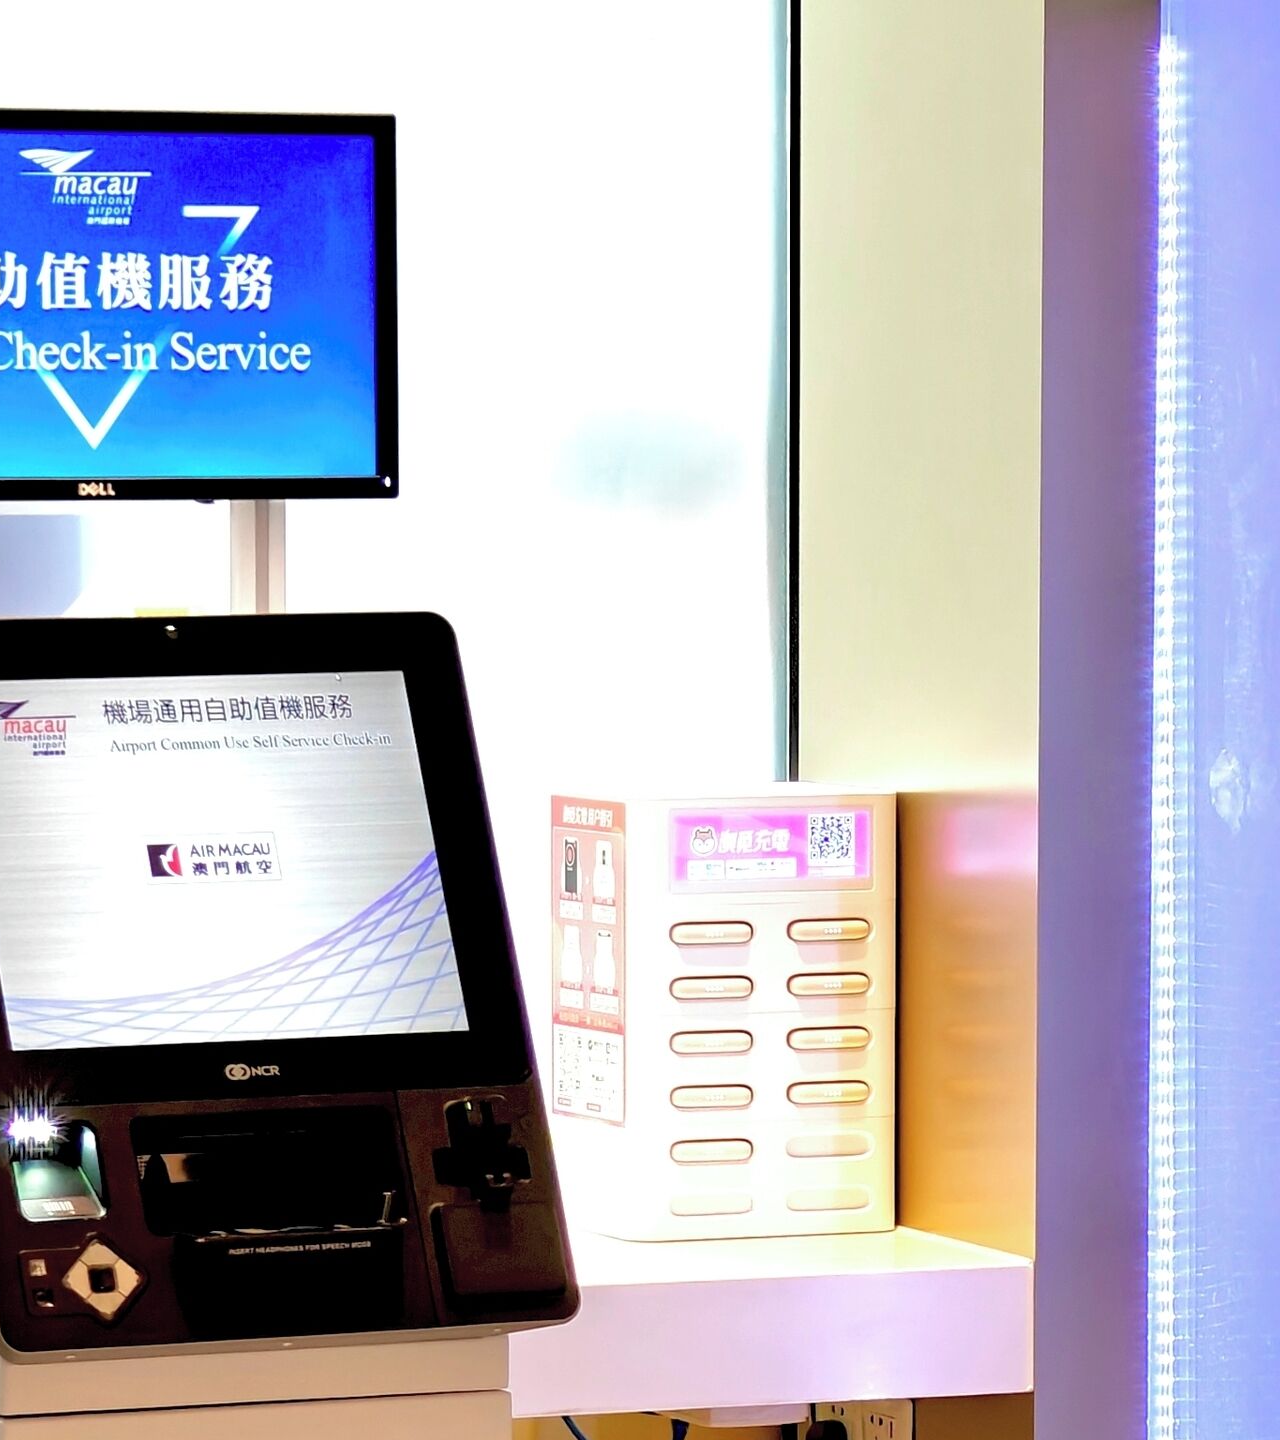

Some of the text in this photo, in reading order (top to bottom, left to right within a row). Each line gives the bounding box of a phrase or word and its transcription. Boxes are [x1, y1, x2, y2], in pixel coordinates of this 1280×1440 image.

[53, 176, 138, 195] macau
[169, 331, 313, 373] Service
[77, 482, 116, 497] DELL
[102, 694, 353, 725] 機場通用自助值機服務
[3, 719, 66, 735] macau
[109, 731, 392, 756] Airport Common Use Self Service Check-in
[189, 841, 271, 858] AIR MACAU
[191, 859, 273, 877] 澳門航空
[251, 1064, 280, 1077] NCR
